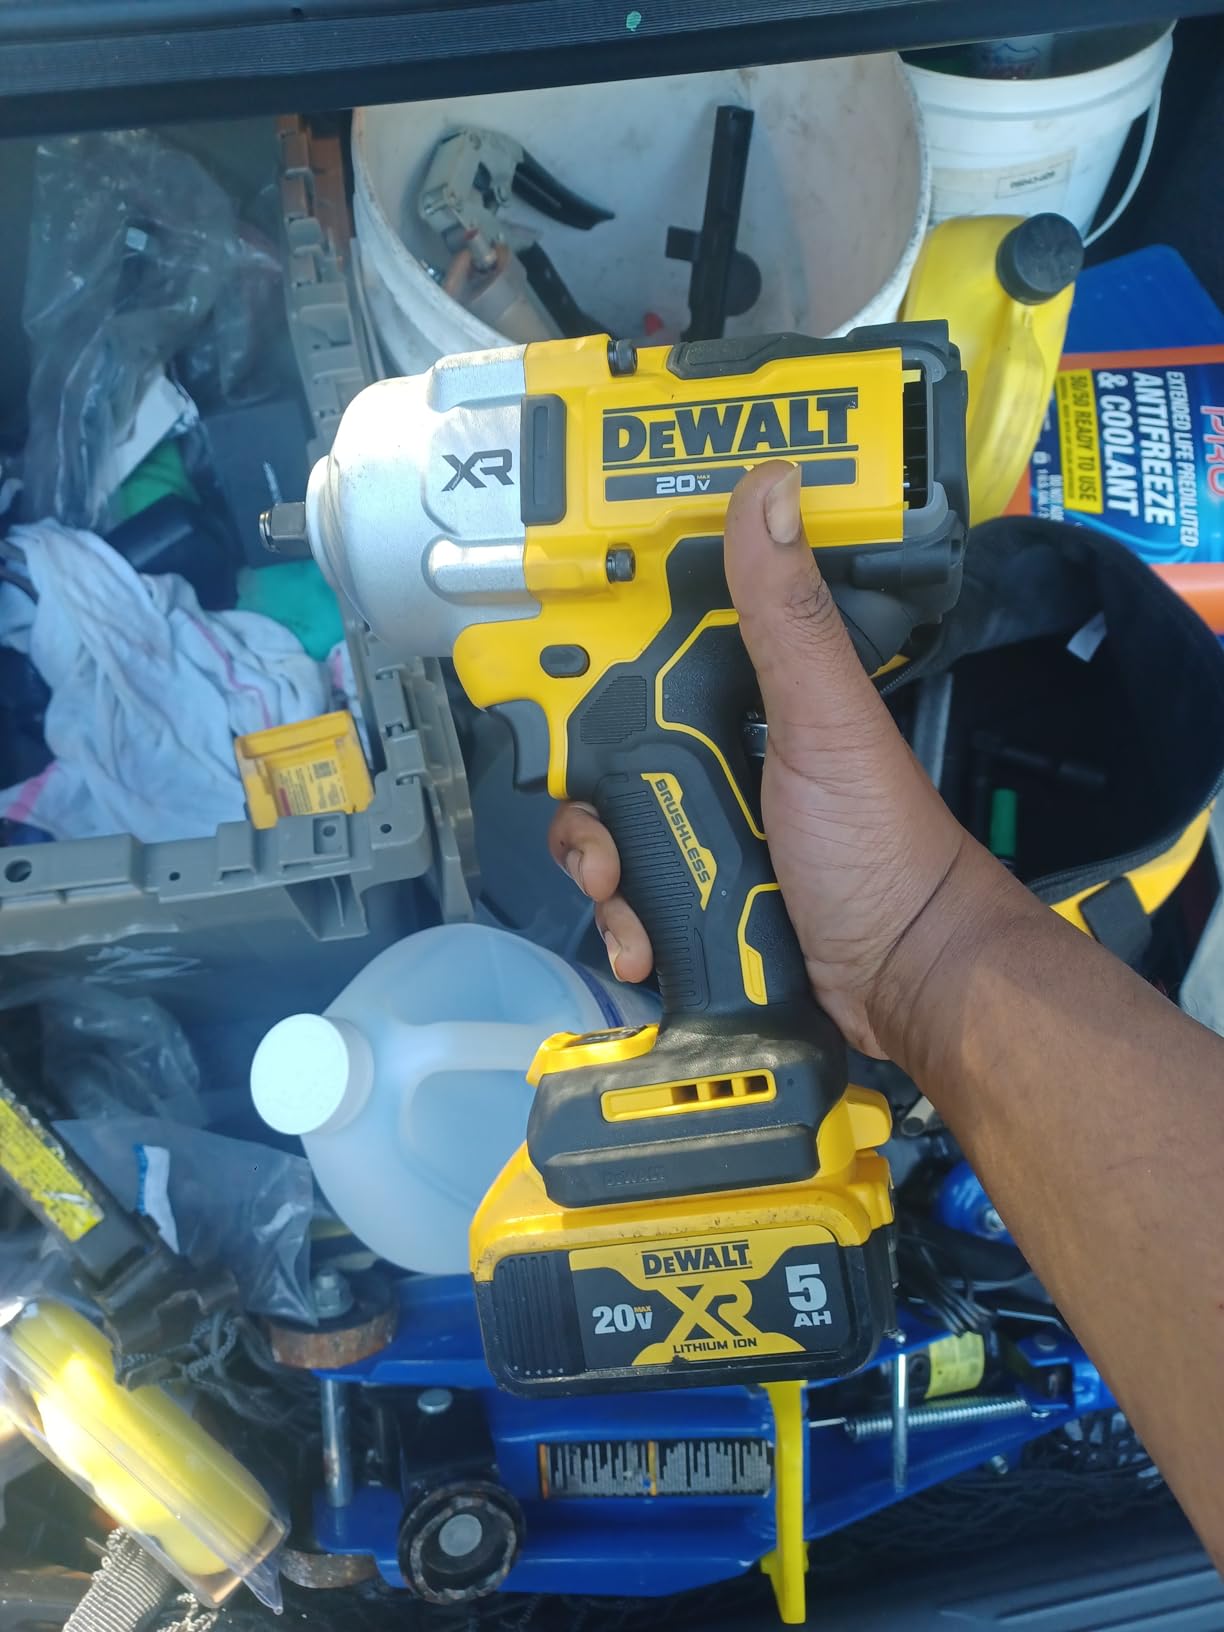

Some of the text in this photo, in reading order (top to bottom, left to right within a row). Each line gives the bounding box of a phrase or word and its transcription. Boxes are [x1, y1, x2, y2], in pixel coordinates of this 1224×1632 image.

[441, 448, 515, 492] XR
[1070, 375, 1097, 502] 50/50 READY TO USE
[1097, 371, 1139, 517] & COOLANT
[1132, 371, 1176, 527] ANTIFREEZE
[1166, 371, 1199, 547] EXTENDED LIFE PREDILUTED
[655, 779, 711, 883] BRUSHLESS
[634, 1305, 652, 1313] MAX
[657, 1280, 763, 1343] XR
[785, 1263, 828, 1312] 5
[793, 1310, 833, 1328] AH
[673, 1337, 757, 1354] LITHIUM ION
